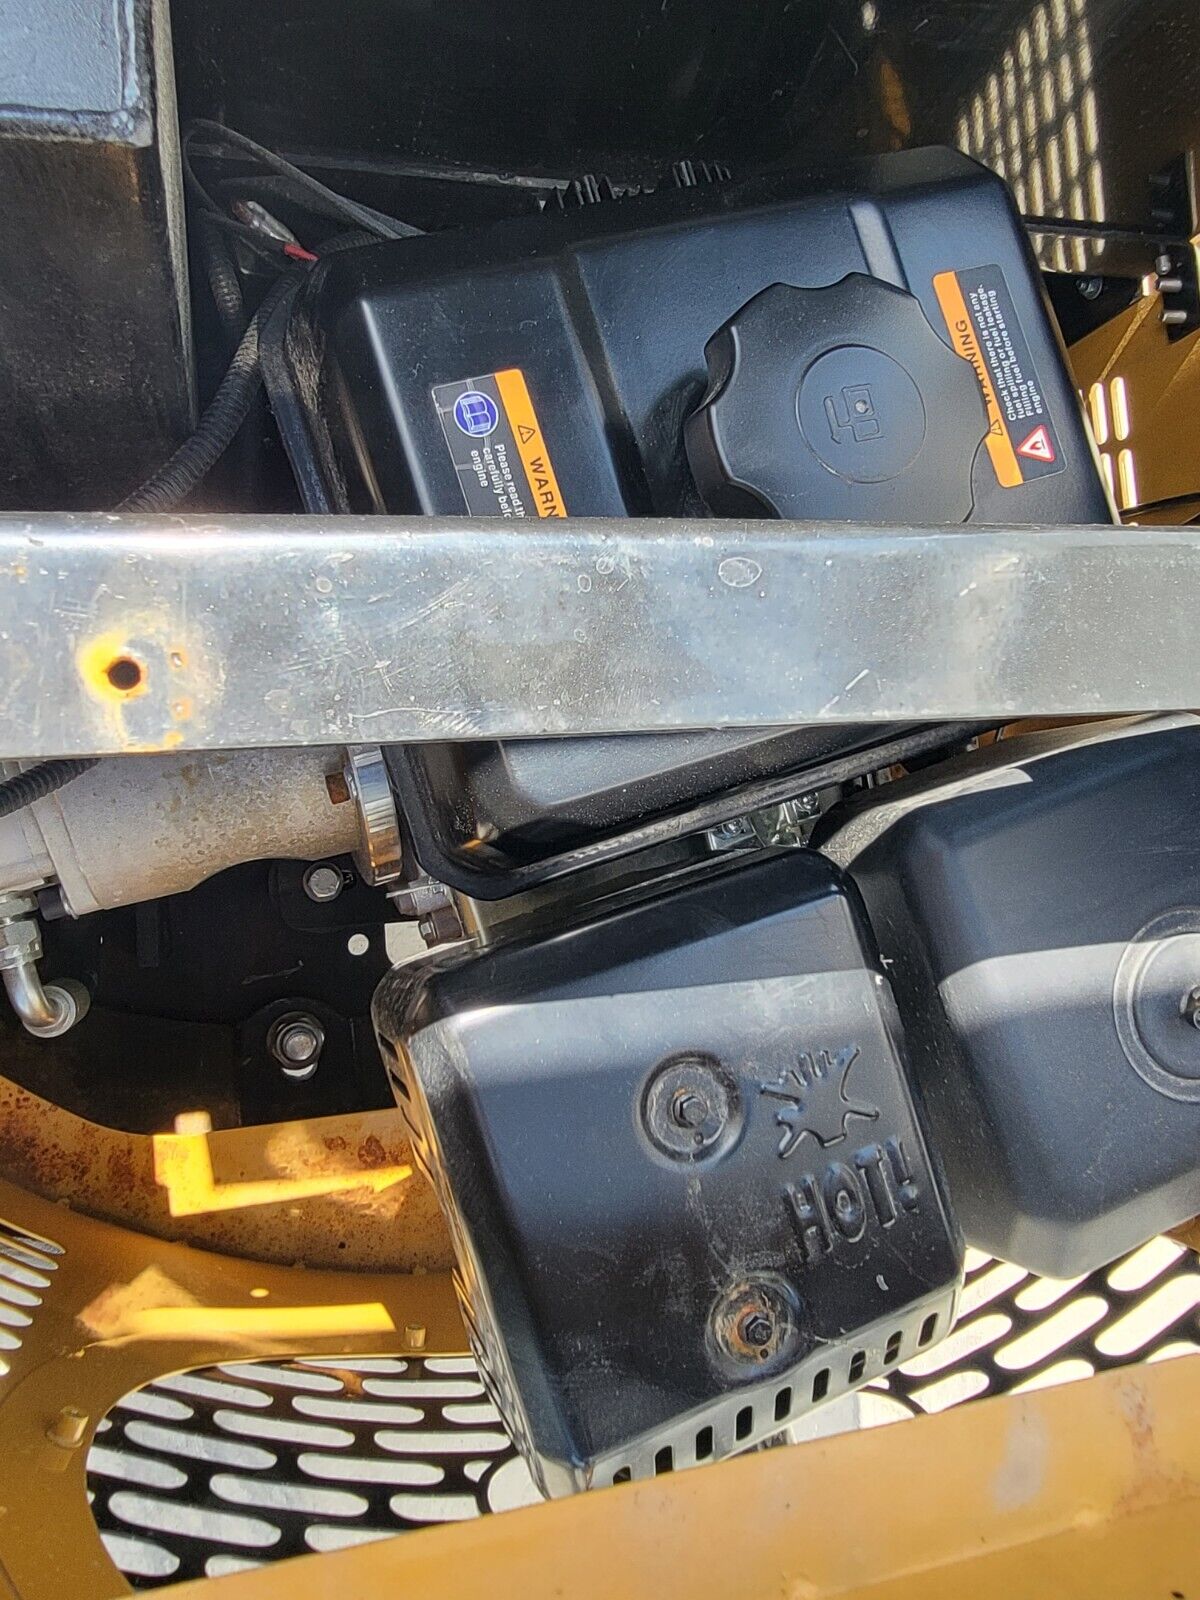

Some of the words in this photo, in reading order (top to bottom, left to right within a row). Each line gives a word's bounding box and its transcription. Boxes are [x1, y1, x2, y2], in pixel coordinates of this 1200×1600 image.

[969, 292, 981, 311] any
[977, 284, 995, 327] leakage.
[987, 290, 1006, 330] starting
[974, 311, 987, 329] not
[982, 330, 991, 340] is
[988, 327, 1003, 347] fuel
[1001, 330, 1017, 364] before
[985, 340, 1000, 368] there
[996, 348, 1006, 359] or
[993, 367, 1007, 389] that
[1001, 360, 1019, 398] spilling
[1010, 363, 1024, 384] fuel
[1000, 389, 1017, 421] Check
[1012, 398, 1026, 419] fuel
[1018, 384, 1035, 417] Filling
[1026, 380, 1043, 414] engine
[470, 449, 489, 487] engine
[482, 446, 505, 494] carefully
[494, 443, 513, 481] Please
[505, 481, 523, 507] read
